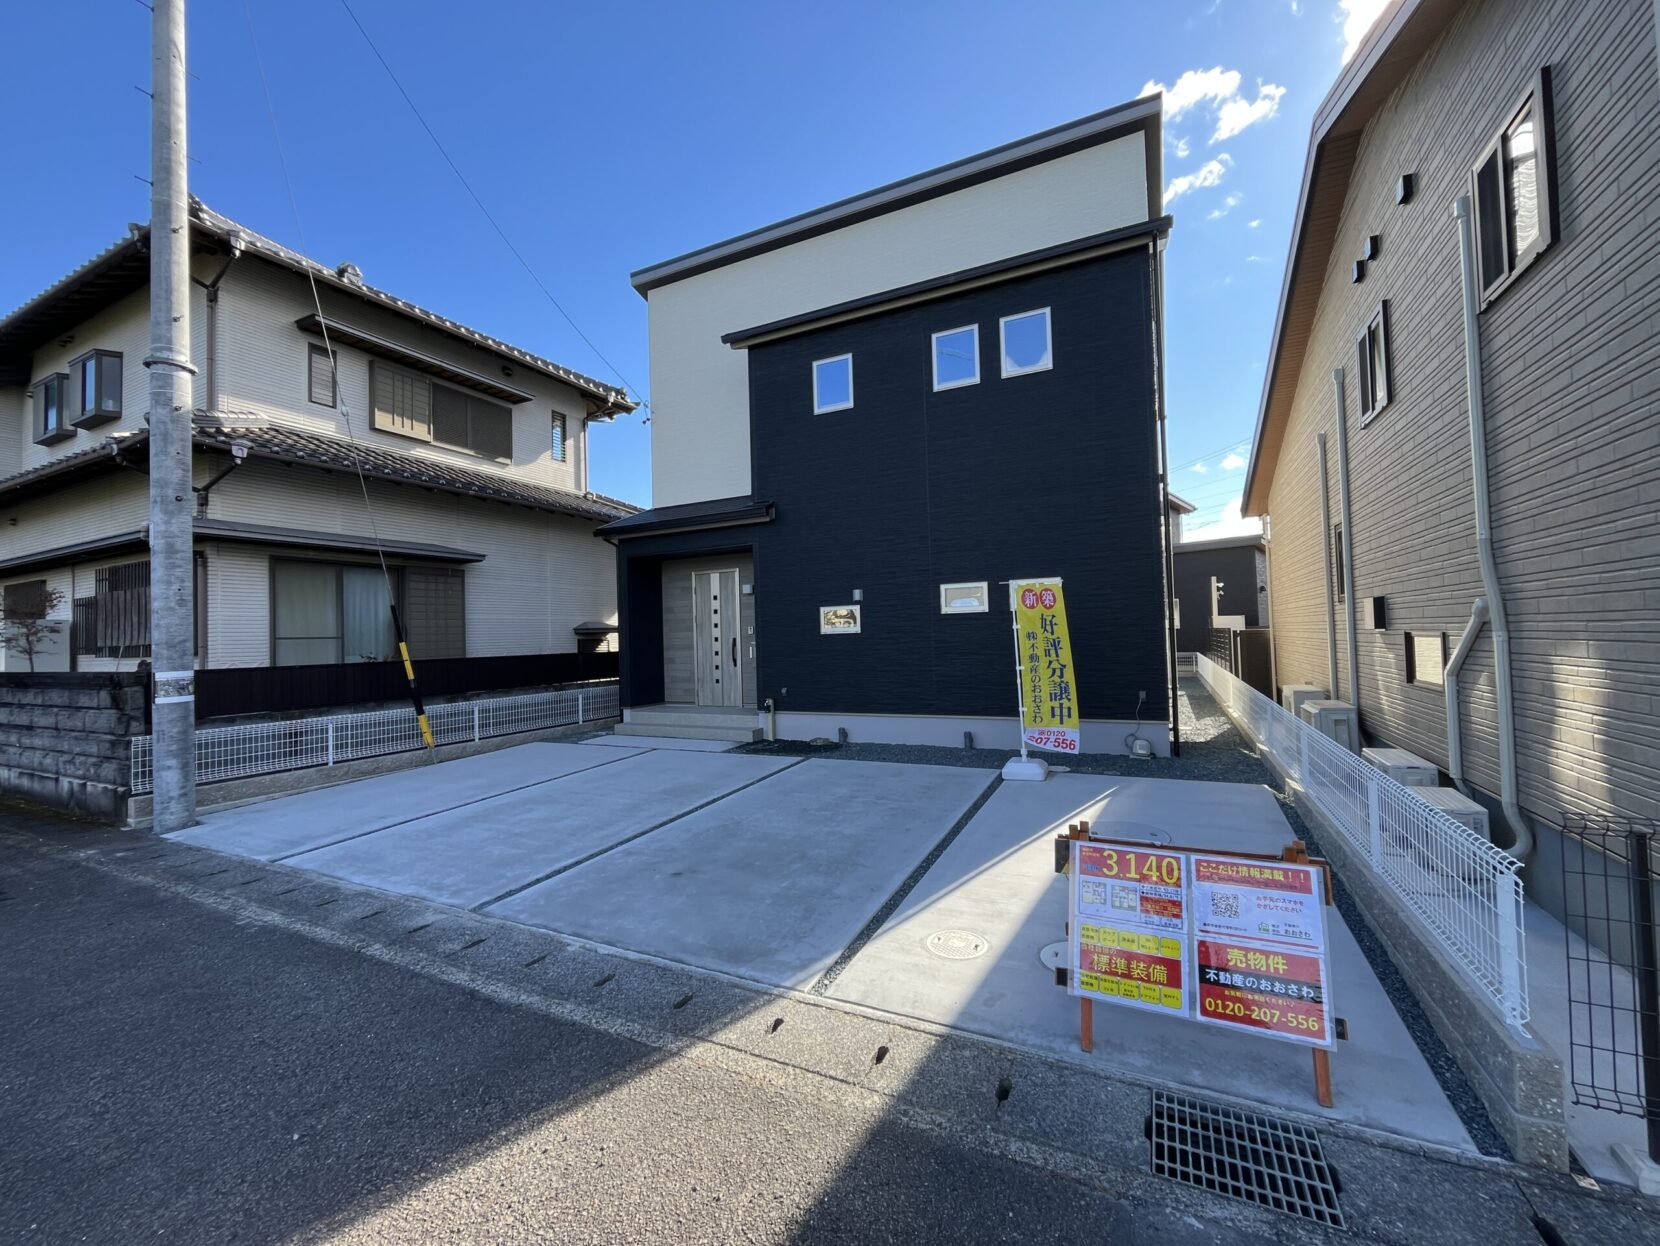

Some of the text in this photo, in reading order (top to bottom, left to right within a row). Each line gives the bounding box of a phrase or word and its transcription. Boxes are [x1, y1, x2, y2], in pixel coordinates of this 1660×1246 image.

[1023, 591, 1055, 608] 新築
[1040, 613, 1072, 725] 好評分譲中
[1102, 850, 1179, 884] 3,140
[1092, 953, 1168, 984] 標準装備
[1227, 948, 1288, 974] 売物件
[1205, 969, 1314, 998] 不動産のおおさわ
[1205, 998, 1319, 1031] 0120-207-556
